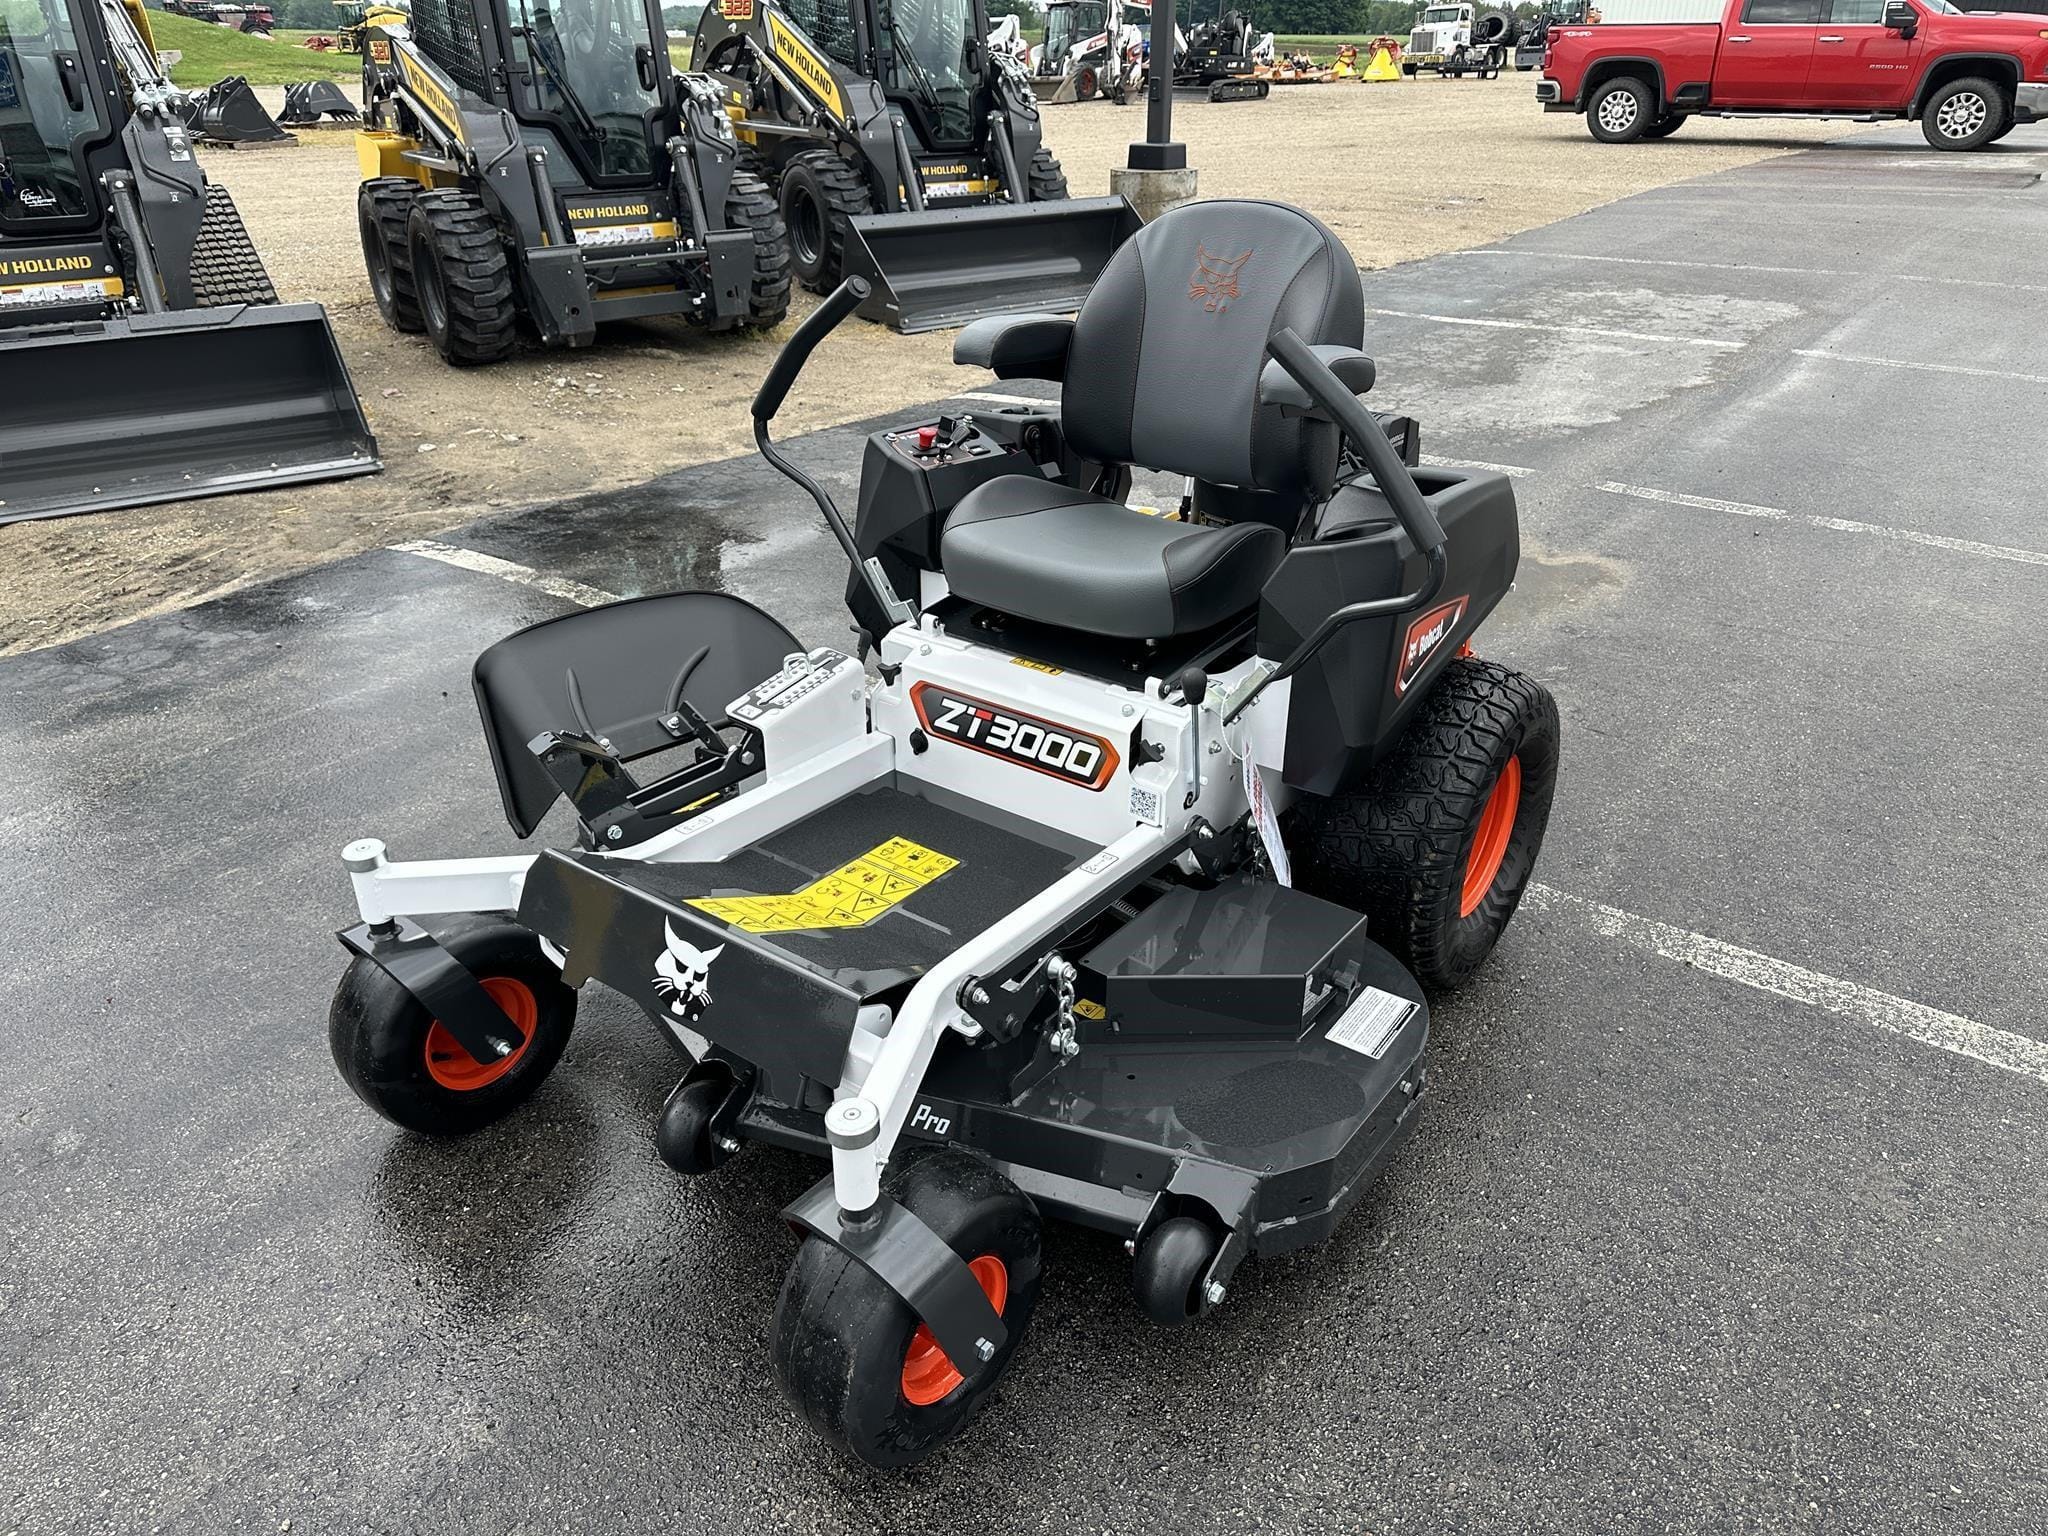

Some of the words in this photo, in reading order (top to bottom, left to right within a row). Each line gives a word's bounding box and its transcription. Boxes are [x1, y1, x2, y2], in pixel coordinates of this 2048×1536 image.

[776, 30, 795, 58] NEW
[795, 49, 832, 95] HOLLAND
[410, 66, 425, 94] NEW
[425, 81, 456, 127] HOLLAND
[931, 165, 968, 175] HOLLAND
[567, 208, 595, 220] NEW
[596, 204, 649, 218] HOLLAND
[12, 256, 92, 274] HOLLAND
[1419, 618, 1444, 656] Bobcat
[910, 1103, 951, 1135] Pro
